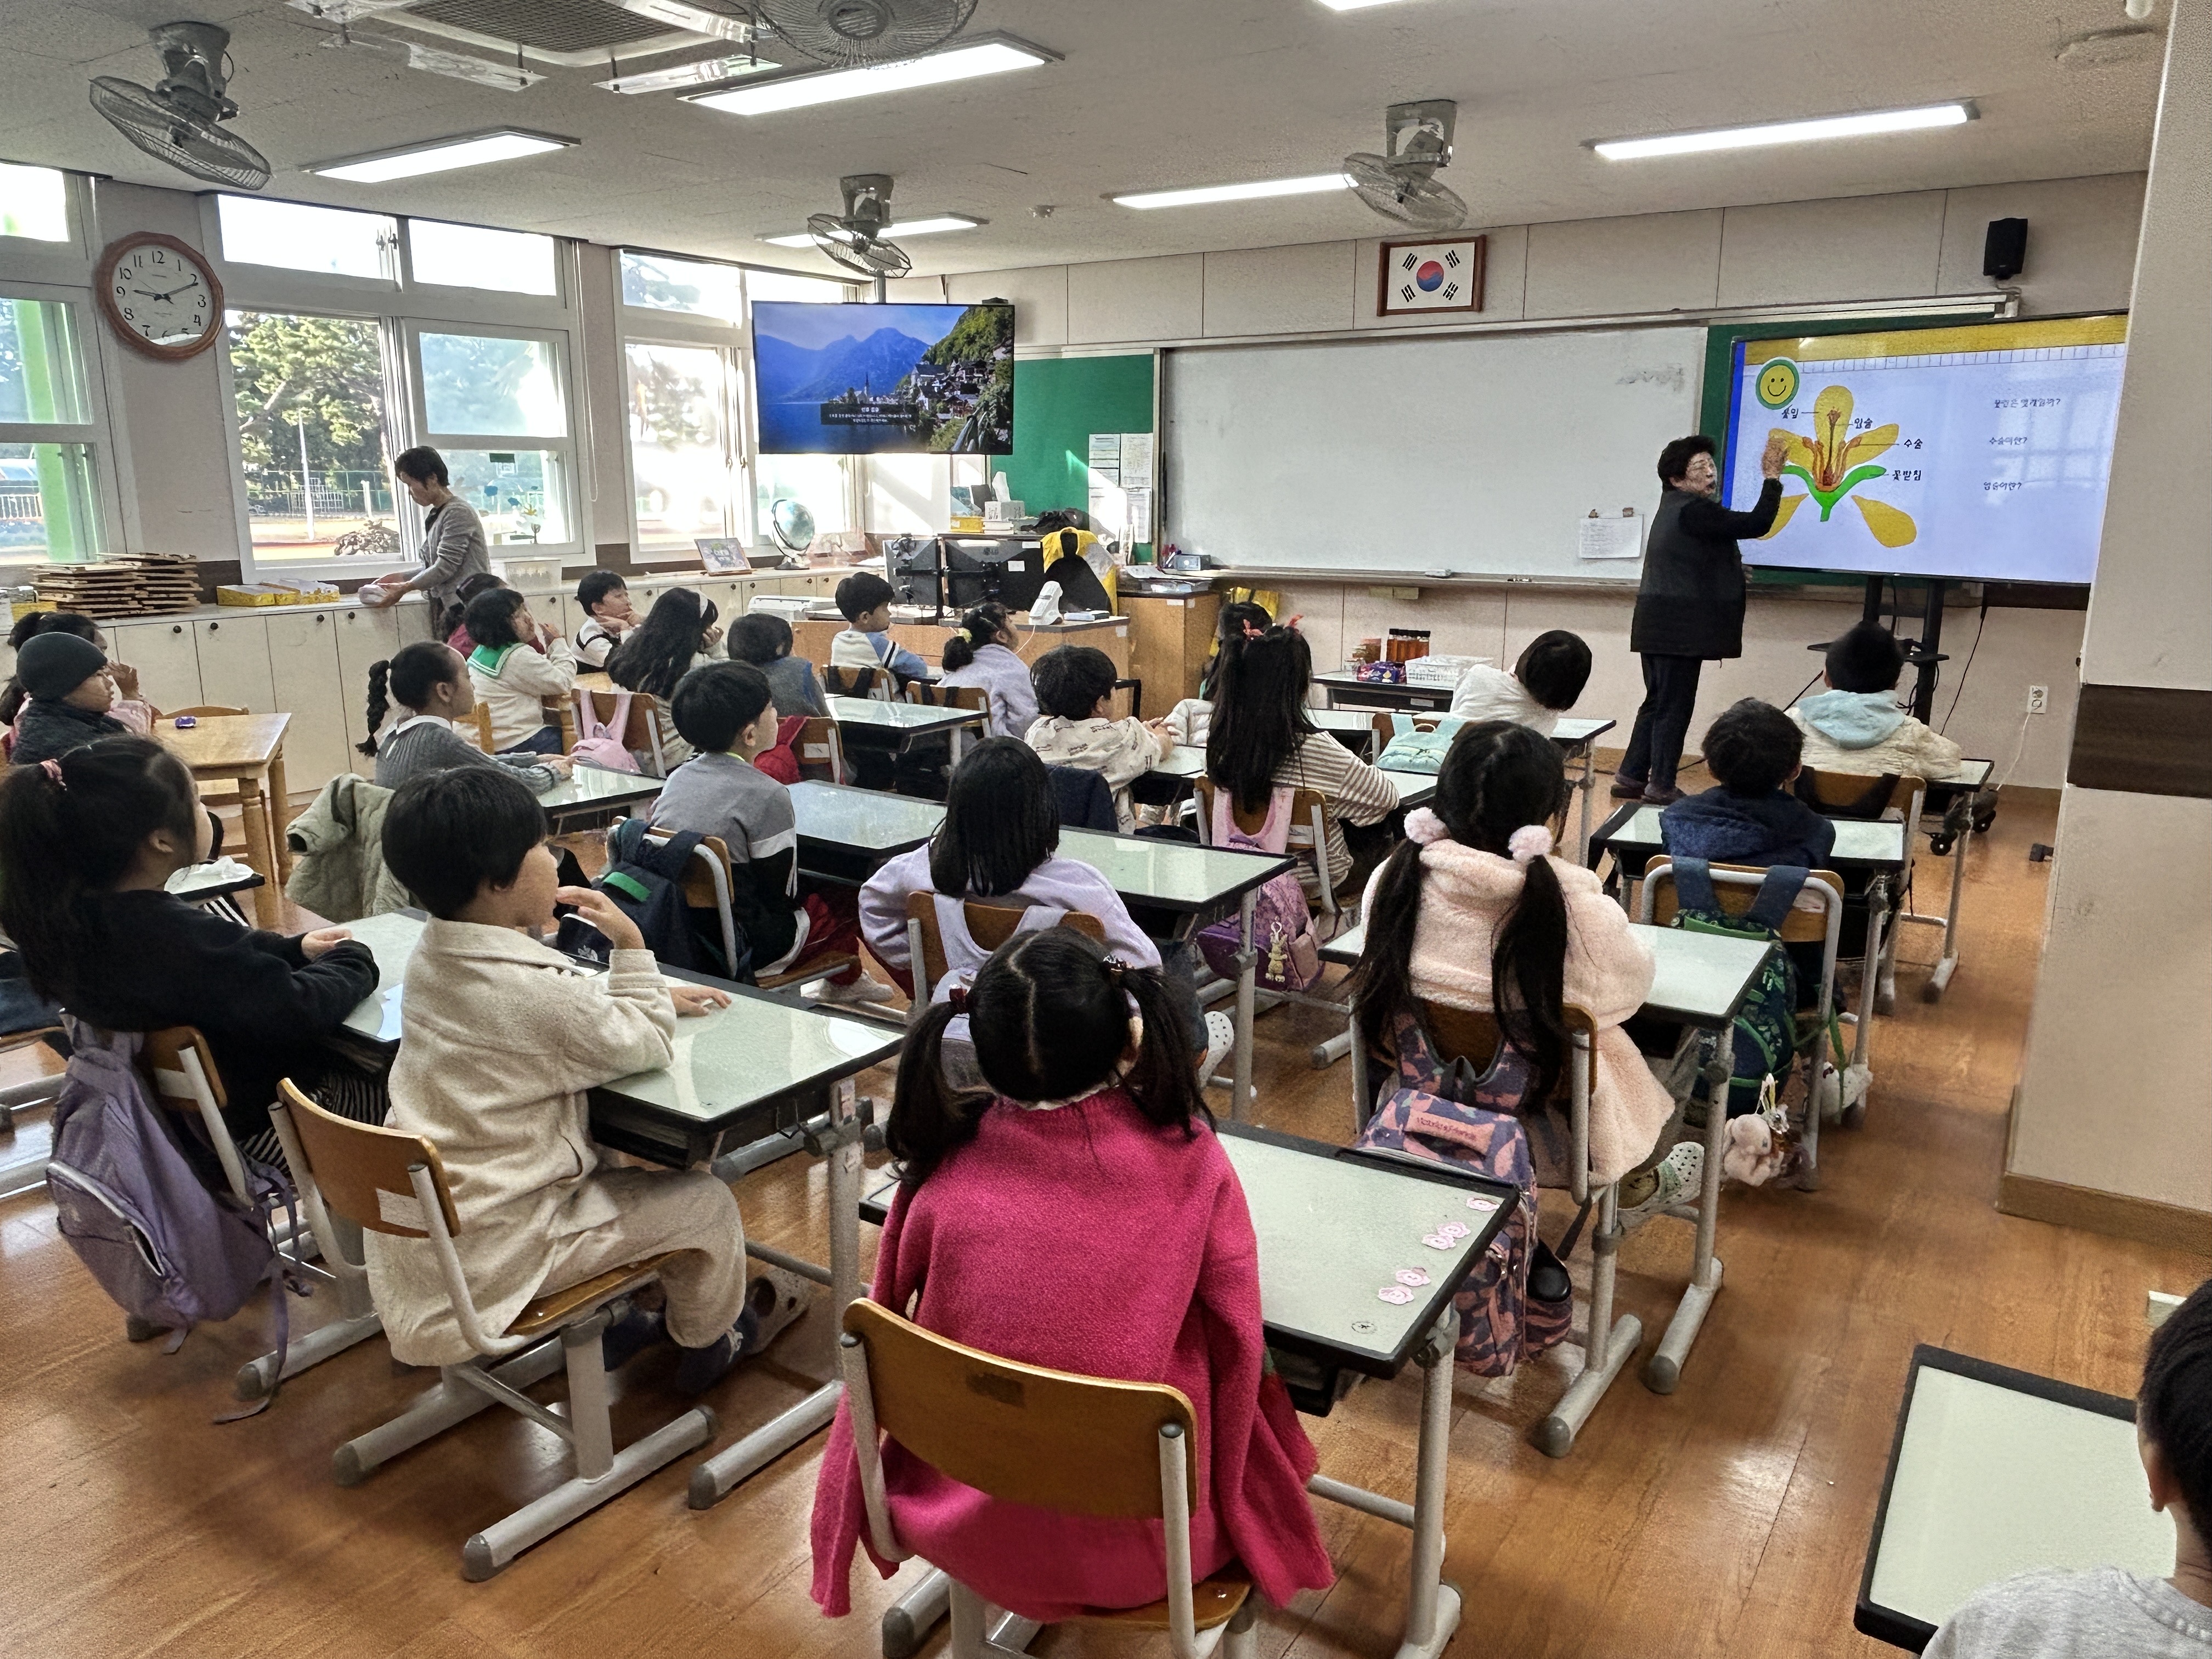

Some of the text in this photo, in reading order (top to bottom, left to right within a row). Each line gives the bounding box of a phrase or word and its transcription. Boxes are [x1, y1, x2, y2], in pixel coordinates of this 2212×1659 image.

[133, 254, 143, 268] 11
[152, 250, 165, 264] 12
[177, 259, 182, 272] 1
[120, 267, 132, 280] 10
[190, 273, 198, 286] 2
[116, 286, 126, 297] 9
[198, 294, 206, 308] 3
[124, 307, 134, 320] 8
[193, 314, 201, 326] 4
[142, 324, 150, 337] 7
[1904, 438, 1923, 449] 수술
[1892, 470, 1921, 481] 꽃받침
